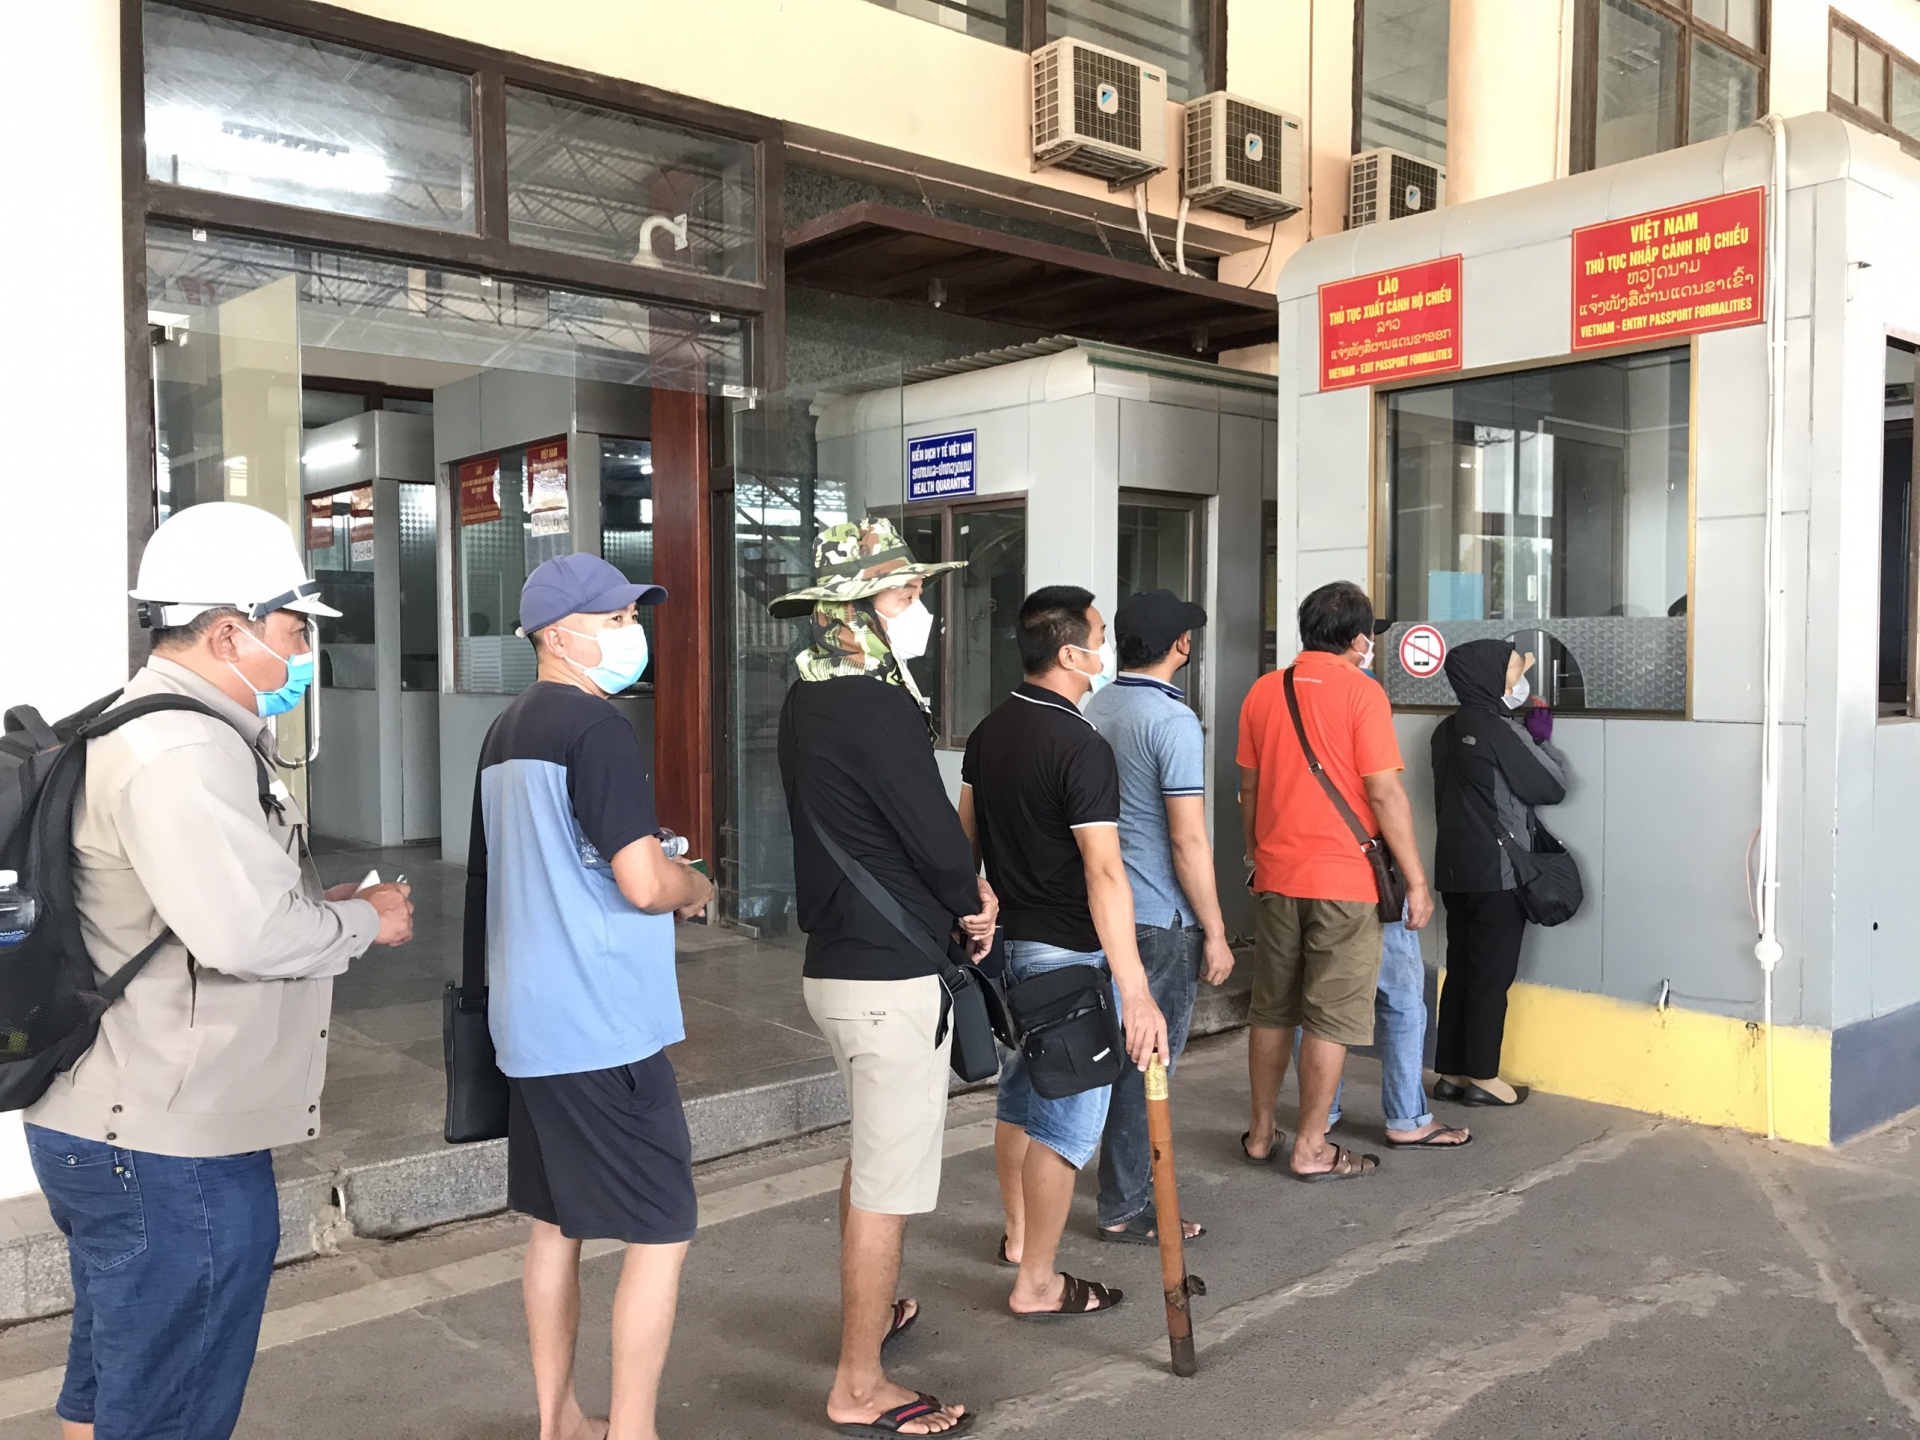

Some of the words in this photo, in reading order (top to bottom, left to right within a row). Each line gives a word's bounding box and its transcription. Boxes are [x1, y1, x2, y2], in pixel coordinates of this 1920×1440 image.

[1631, 219, 1660, 245] VIỆT
[1664, 212, 1698, 236] NAM
[1585, 252, 1604, 275] THỦ
[1607, 254, 1627, 273] TỤC
[1630, 245, 1659, 267] NHẬP
[1662, 236, 1692, 260] CẢNH
[1696, 233, 1711, 255] HỘ
[1714, 222, 1749, 249] CHIẾU
[1378, 276, 1398, 296] LÀO
[1627, 259, 1700, 289] ຫວຽດນາມ
[1329, 305, 1344, 326] THỦ
[1346, 307, 1362, 325] TỤC
[1363, 298, 1384, 319] XUẤT
[1386, 294, 1409, 315] CẢNH
[1412, 291, 1423, 310] HỘ
[1426, 283, 1452, 306] CHIẾU
[1581, 321, 1614, 338] VIETNAM
[1622, 315, 1647, 332] ENTRY
[1649, 307, 1692, 326] PASSPORT
[1695, 297, 1752, 319] FORMALITIES
[1377, 318, 1401, 333] ລາວ
[1329, 365, 1355, 380] VIETNAM
[1360, 362, 1374, 374] EXIT
[1375, 355, 1409, 371] PASSPORT
[1410, 348, 1453, 365] FORMALITIES
[937, 447, 940, 458] Y
[941, 441, 948, 457] TẾ
[949, 441, 960, 458] VIỆT
[961, 442, 972, 454] NAM
[914, 481, 935, 495] HEALTH
[936, 476, 970, 493] QUARANTINE
